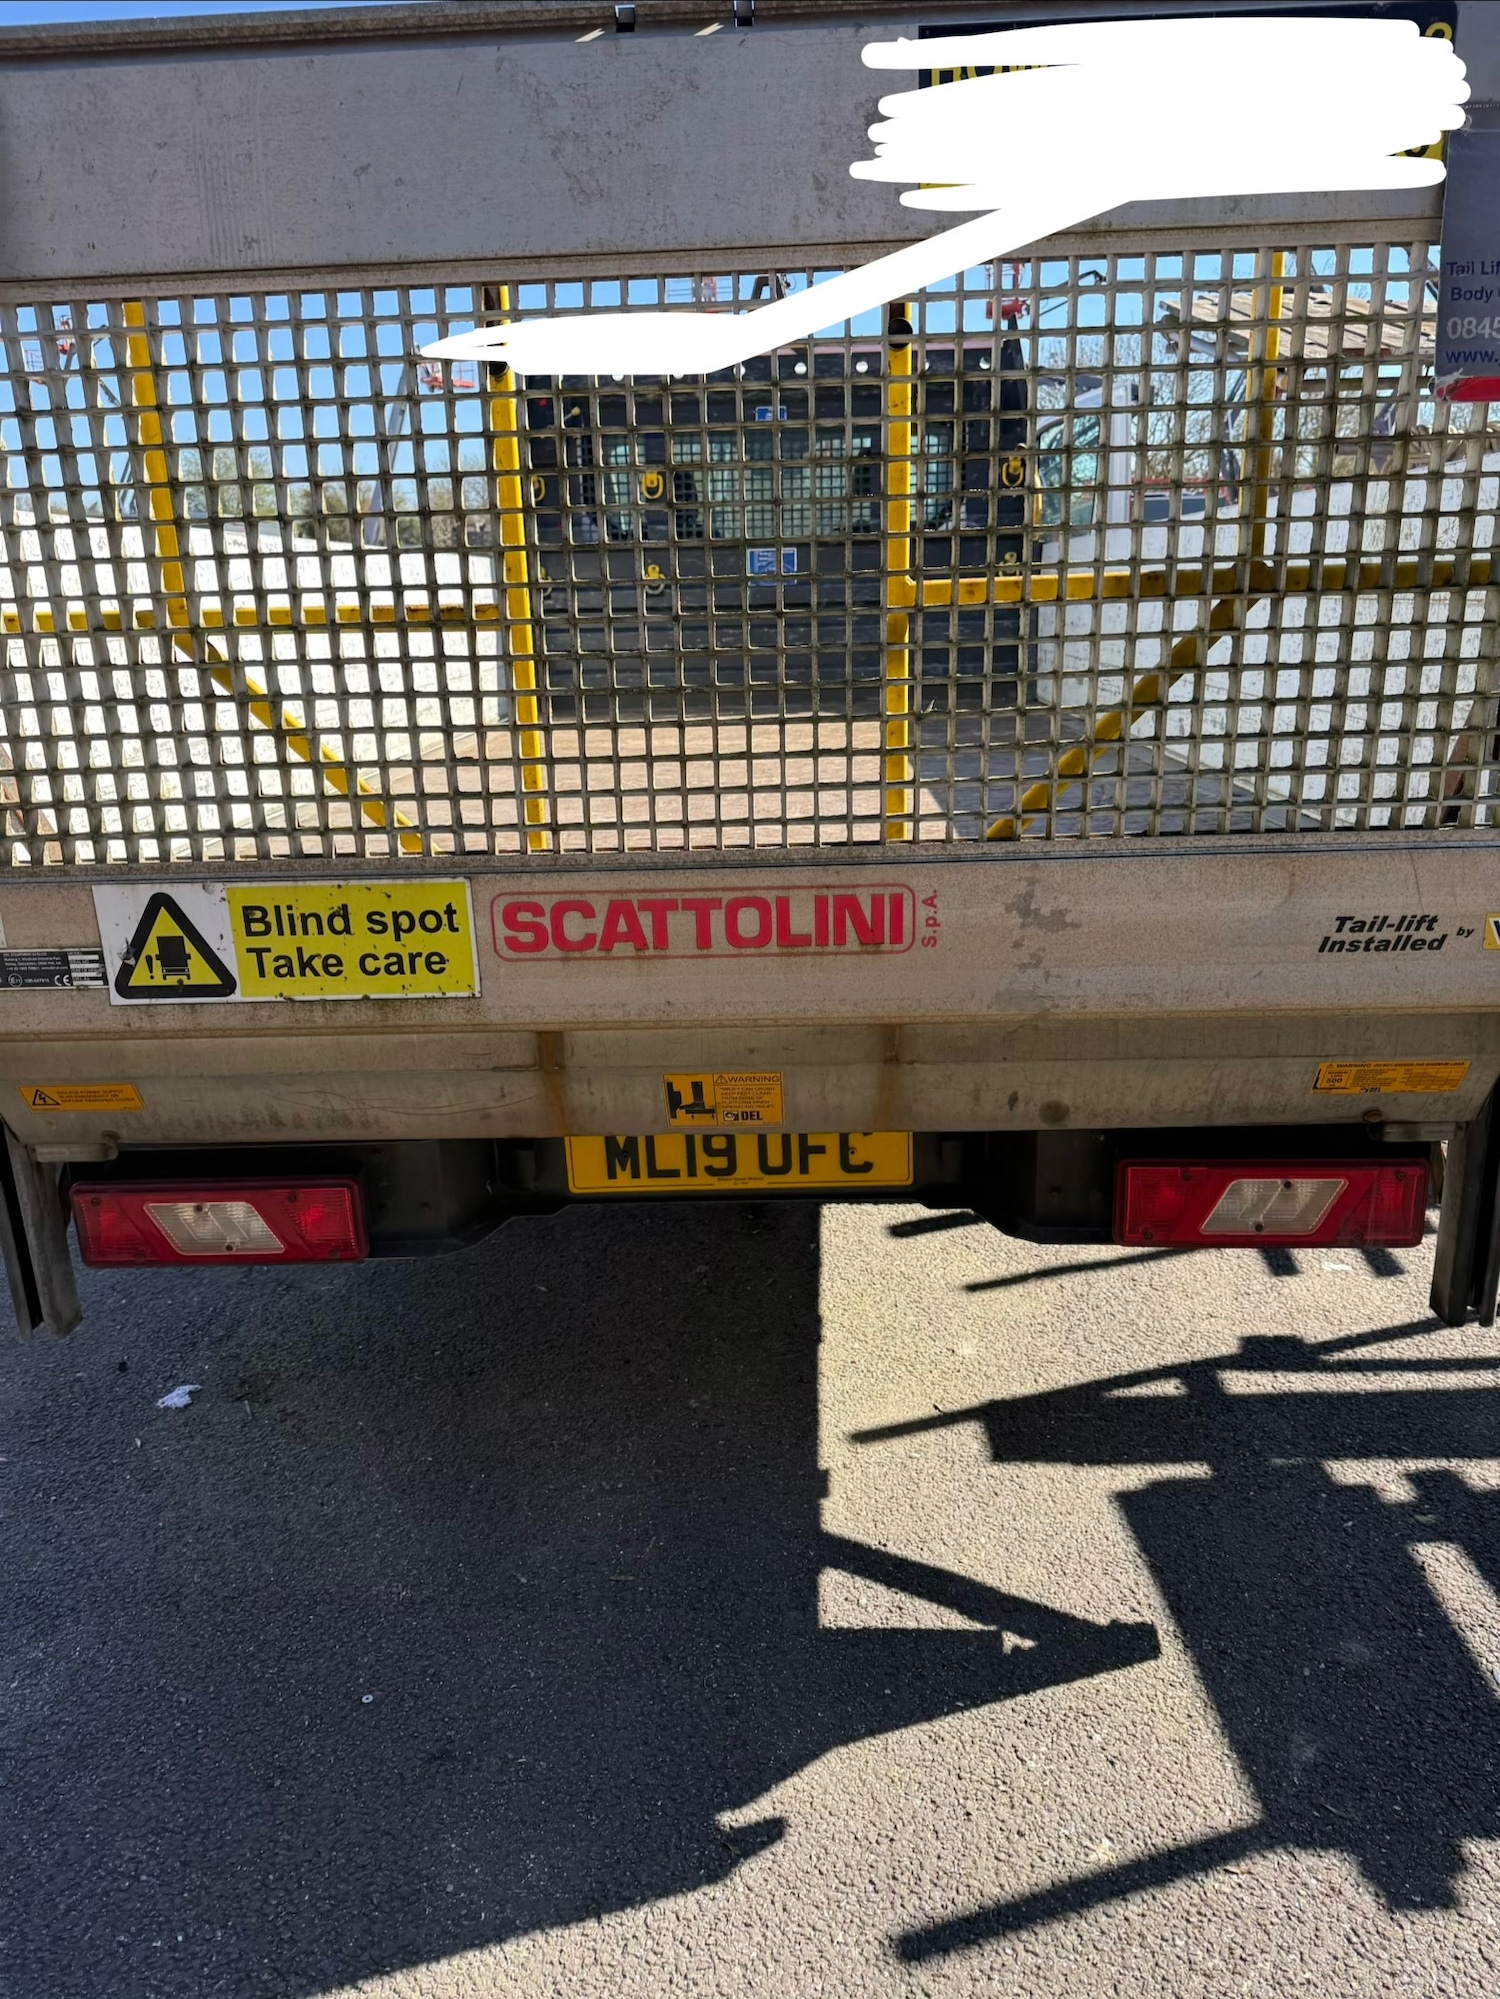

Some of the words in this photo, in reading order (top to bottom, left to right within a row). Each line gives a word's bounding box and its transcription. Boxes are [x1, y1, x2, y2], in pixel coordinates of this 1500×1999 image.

[1446, 261, 1474, 275] Tail
[1451, 286, 1494, 304] Body
[1445, 350, 1500, 365] www.
[241, 903, 351, 937] Blind
[366, 902, 459, 942] spot
[502, 892, 904, 953] SCATTOLINI
[921, 889, 939, 949] S.p.A.
[1335, 914, 1440, 933] Tail-lift
[1456, 926, 1475, 939] by
[1318, 934, 1448, 953] Installed
[246, 946, 344, 978] Take
[359, 950, 447, 977] care
[727, 1075, 780, 1083] WARNING
[741, 1111, 763, 1120] DEL
